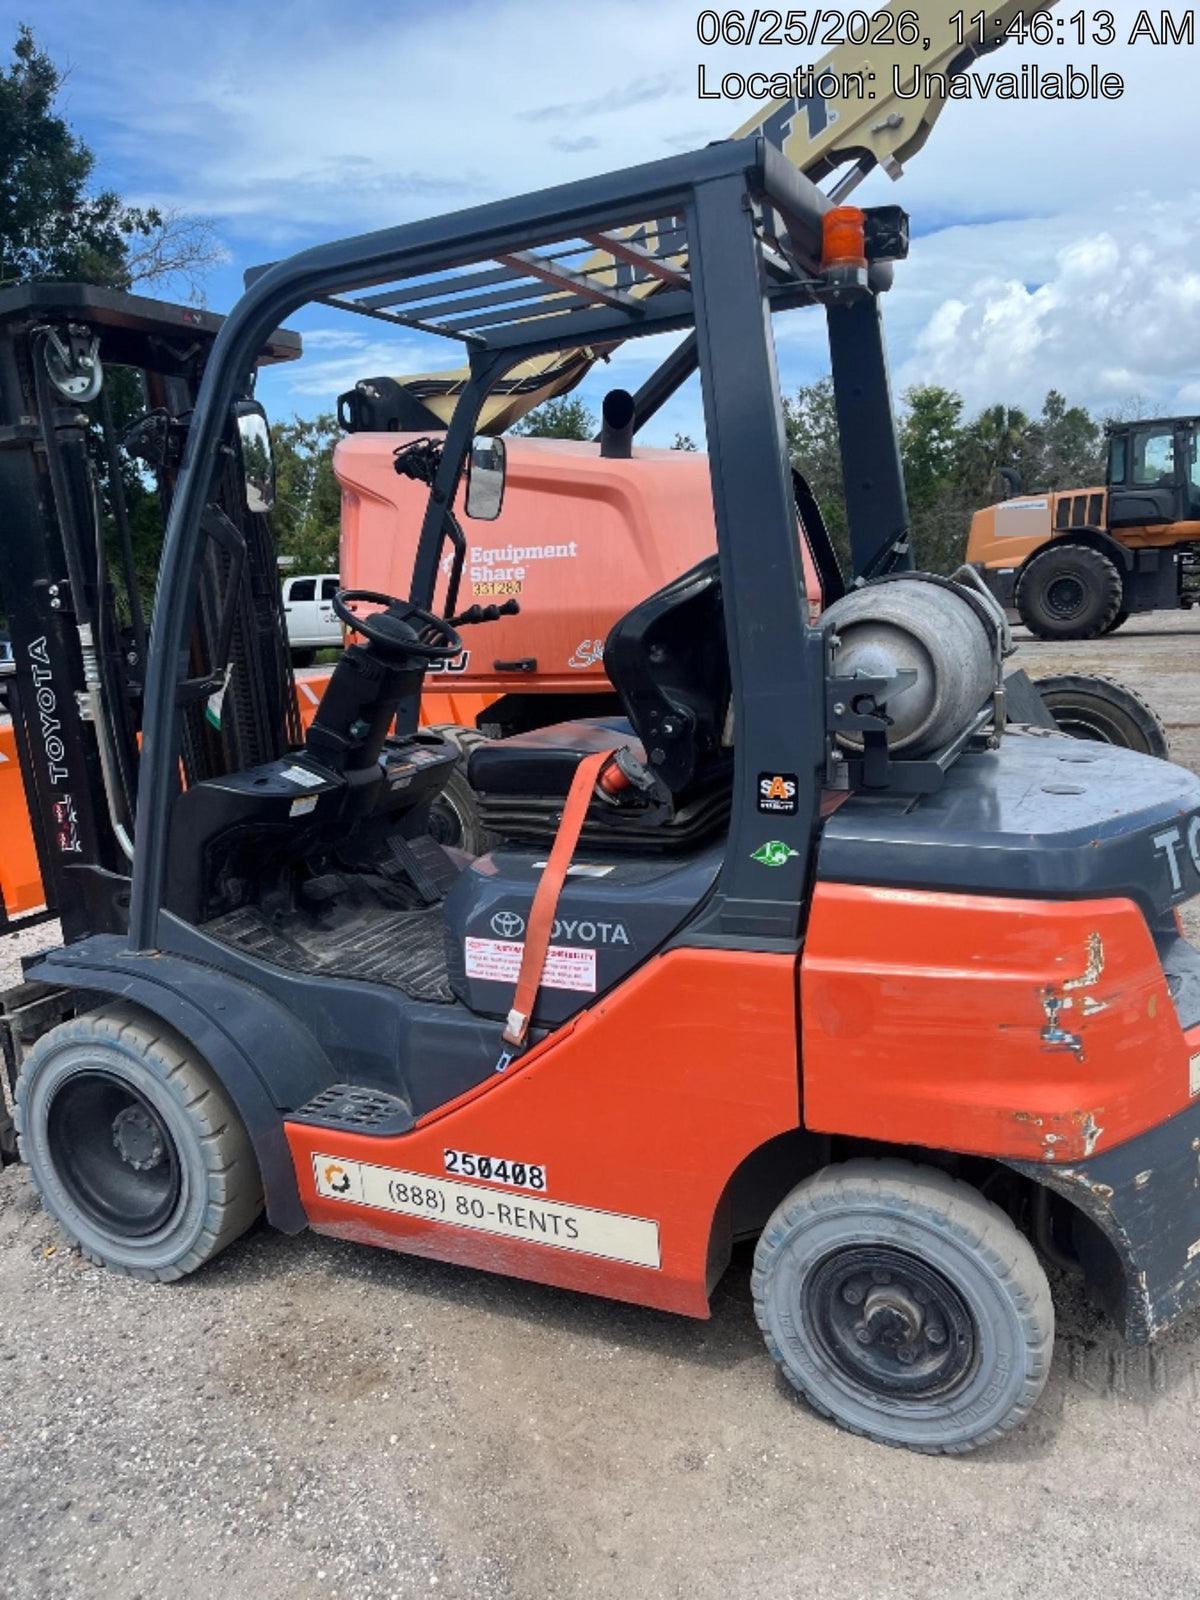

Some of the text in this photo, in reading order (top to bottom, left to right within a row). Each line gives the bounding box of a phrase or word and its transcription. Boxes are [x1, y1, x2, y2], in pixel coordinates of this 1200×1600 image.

[470, 541, 578, 566] Equipment
[470, 566, 526, 583] Share
[28, 636, 69, 785] TOYOTA
[760, 776, 796, 799] SAS
[444, 1150, 546, 1190] 250408
[388, 1180, 580, 1240] (888) 80-RENTS
